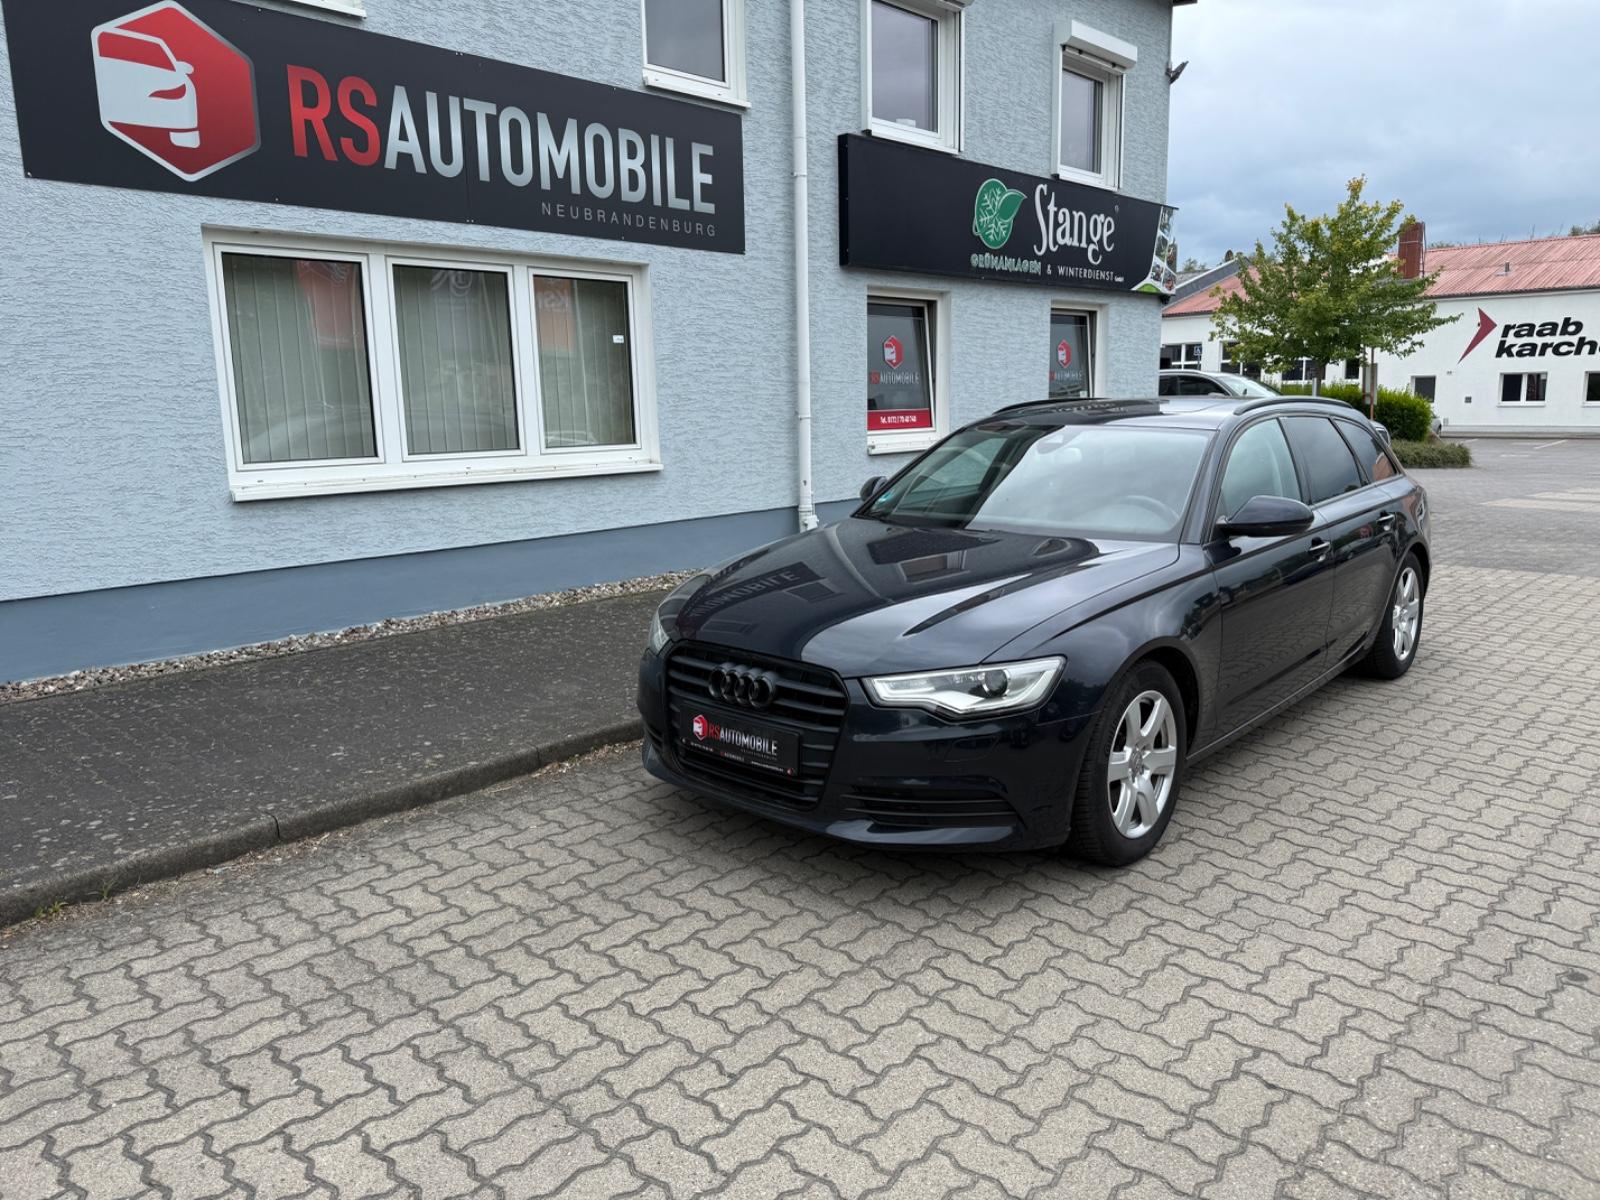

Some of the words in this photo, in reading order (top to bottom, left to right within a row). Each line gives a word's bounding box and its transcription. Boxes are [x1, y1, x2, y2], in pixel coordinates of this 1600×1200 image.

[541, 202, 717, 237] NEUBRANDENBURG
[1033, 184, 1115, 265] Stange
[1046, 264, 1052, 275] &
[1057, 265, 1114, 281] WINTERDIENST
[1501, 317, 1583, 339] raab
[1495, 336, 1600, 358] karch
